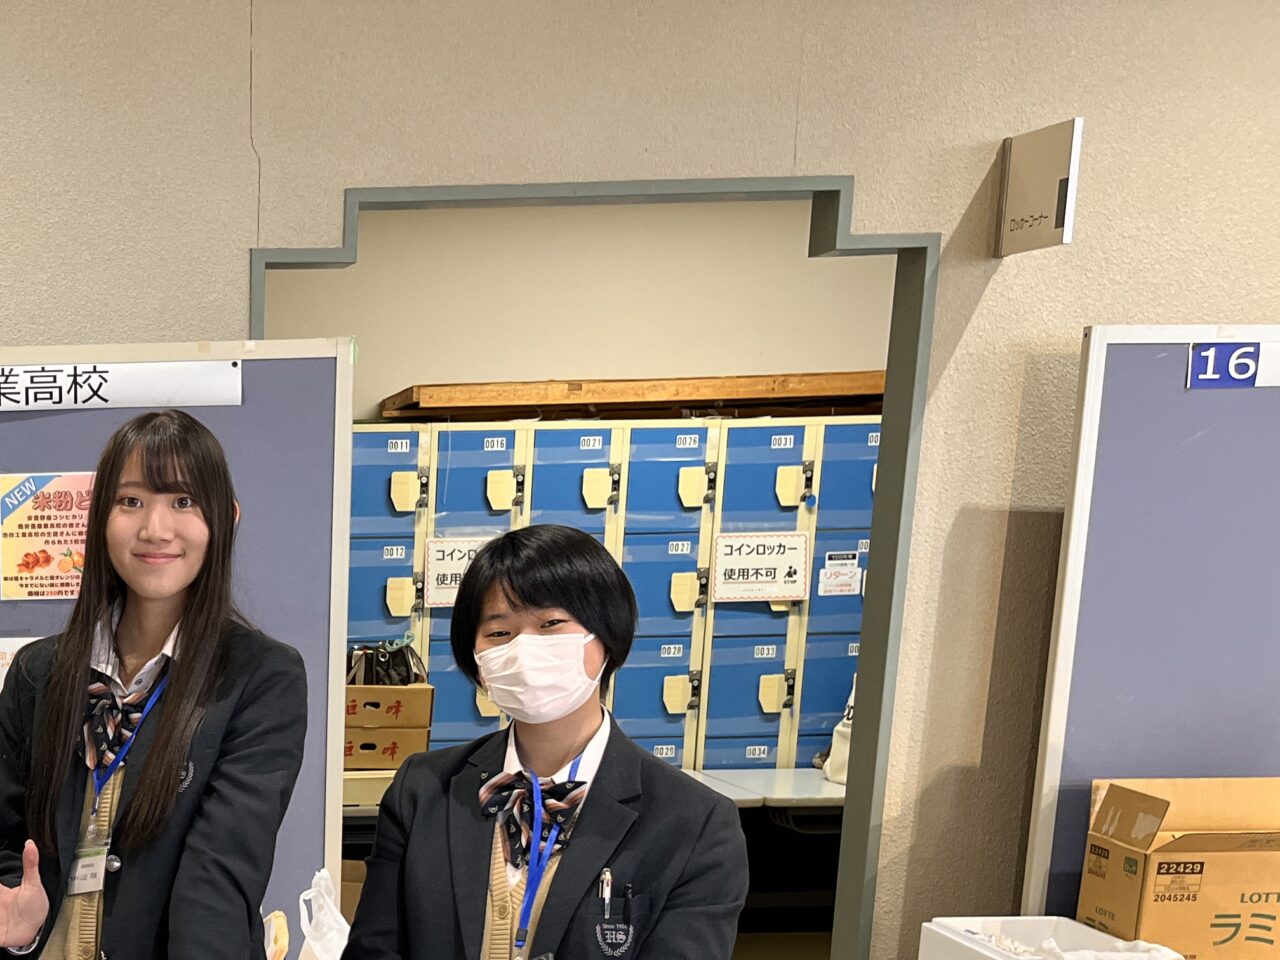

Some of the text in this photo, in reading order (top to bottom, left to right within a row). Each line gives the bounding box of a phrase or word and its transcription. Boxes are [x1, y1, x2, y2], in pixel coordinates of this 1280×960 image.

[1197, 346, 1257, 380] 16
[388, 441, 409, 451] 0011
[485, 439, 505, 449] 0016
[581, 438, 602, 448] 0021
[677, 436, 698, 447] 0026
[772, 436, 793, 447] 0031
[4, 478, 38, 509] NEW
[384, 547, 404, 557] 0012
[669, 542, 690, 552] 0027
[723, 543, 798, 556] コインロッカー
[723, 567, 777, 581] 使用不可
[1160, 863, 1201, 873] 22429
[1153, 893, 1197, 902] 2045245
[1240, 892, 1280, 904] LOTT
